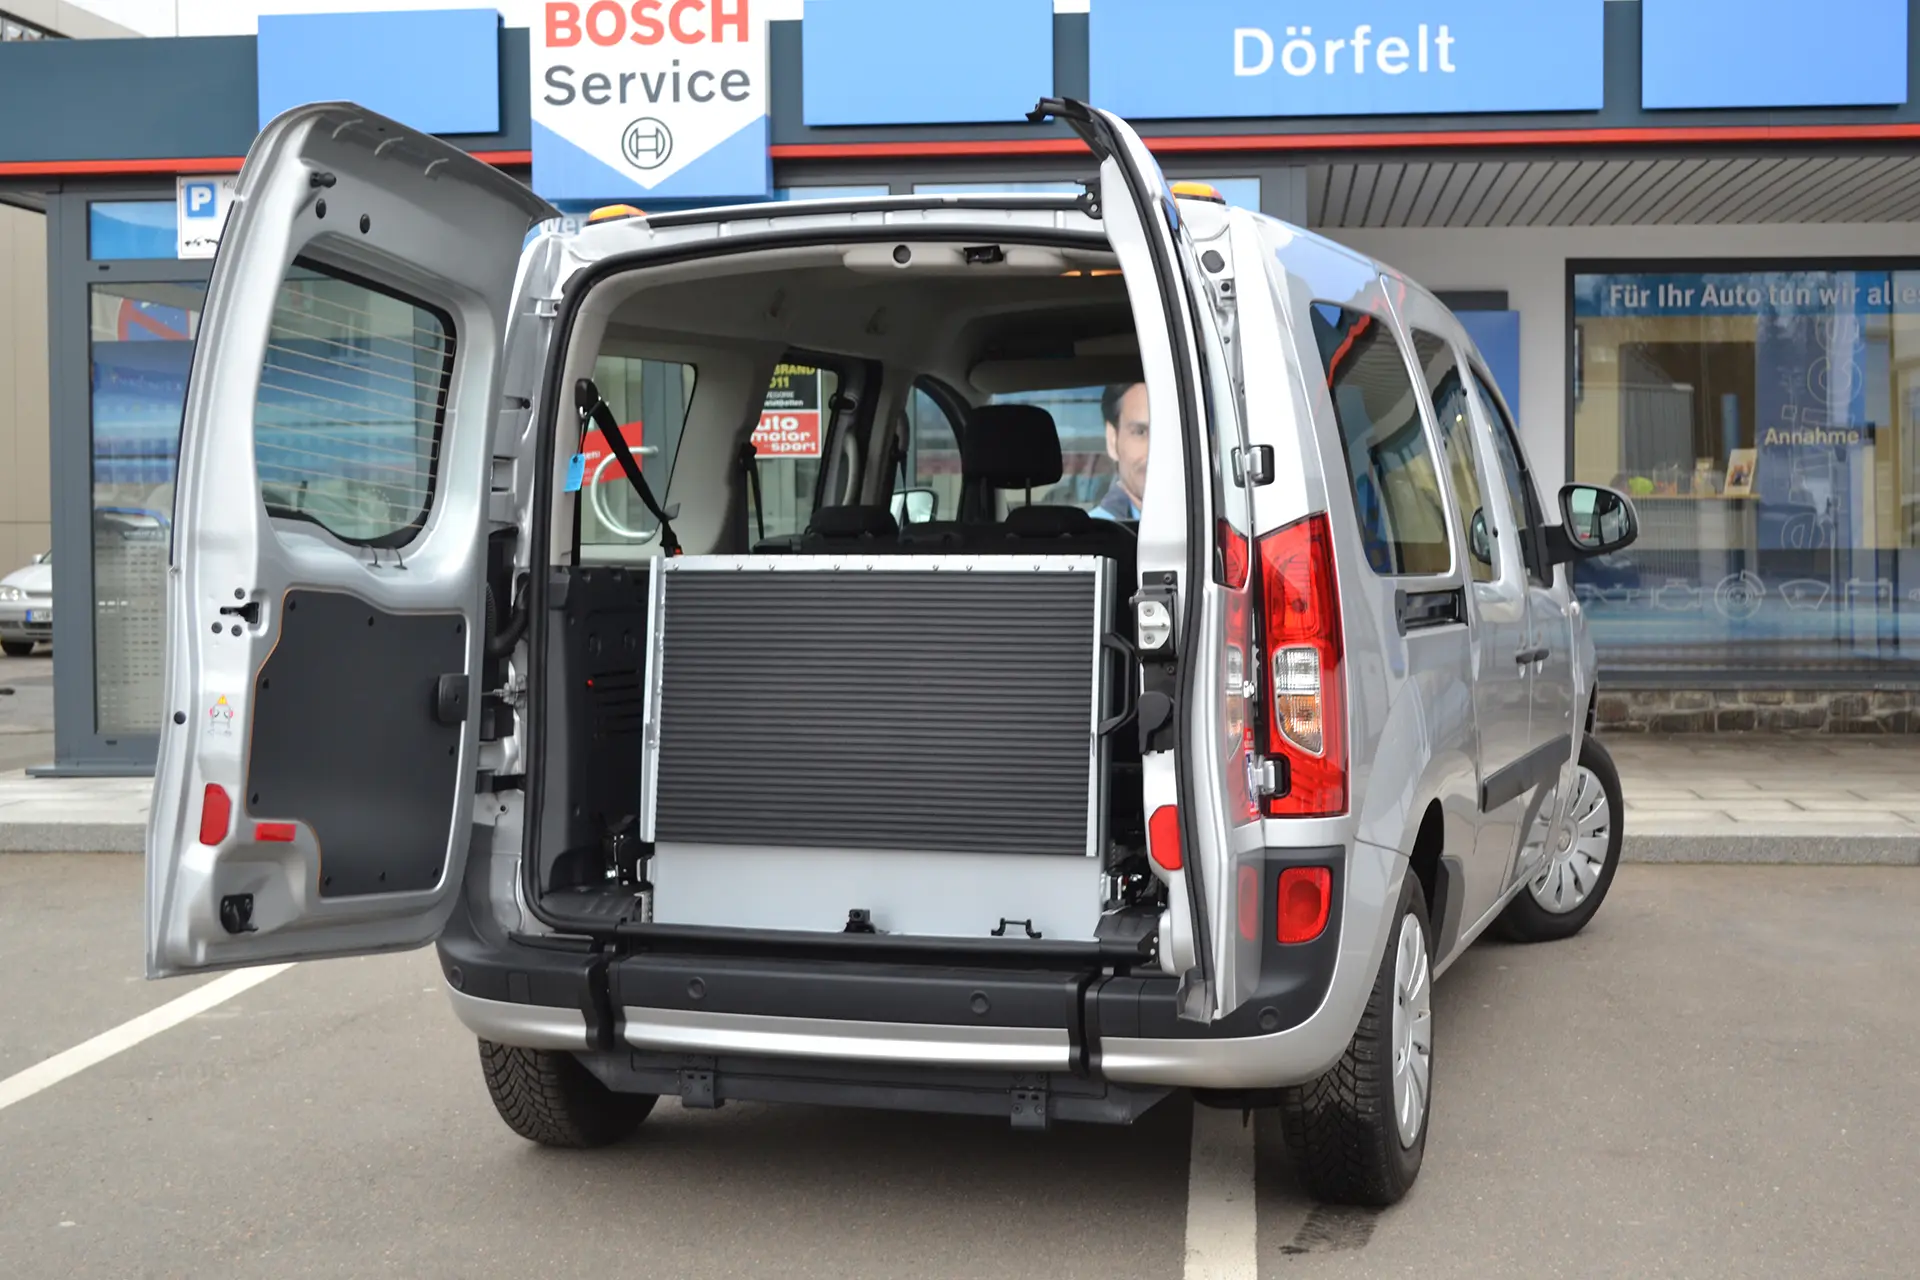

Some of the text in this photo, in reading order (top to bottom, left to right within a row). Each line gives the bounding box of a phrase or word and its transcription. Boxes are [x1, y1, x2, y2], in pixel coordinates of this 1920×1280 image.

[545, 0, 750, 47] BOSCH
[1234, 23, 1456, 77] Dörfelt
[544, 59, 750, 106] Service
[191, 187, 212, 211] P
[1609, 284, 1650, 308] Für
[1658, 284, 1694, 308] Ihr
[1701, 284, 1761, 307] Auto
[1769, 284, 1810, 306] tun
[1819, 281, 1860, 306] wir
[756, 415, 799, 431] uto
[1764, 426, 1859, 446] Annahme
